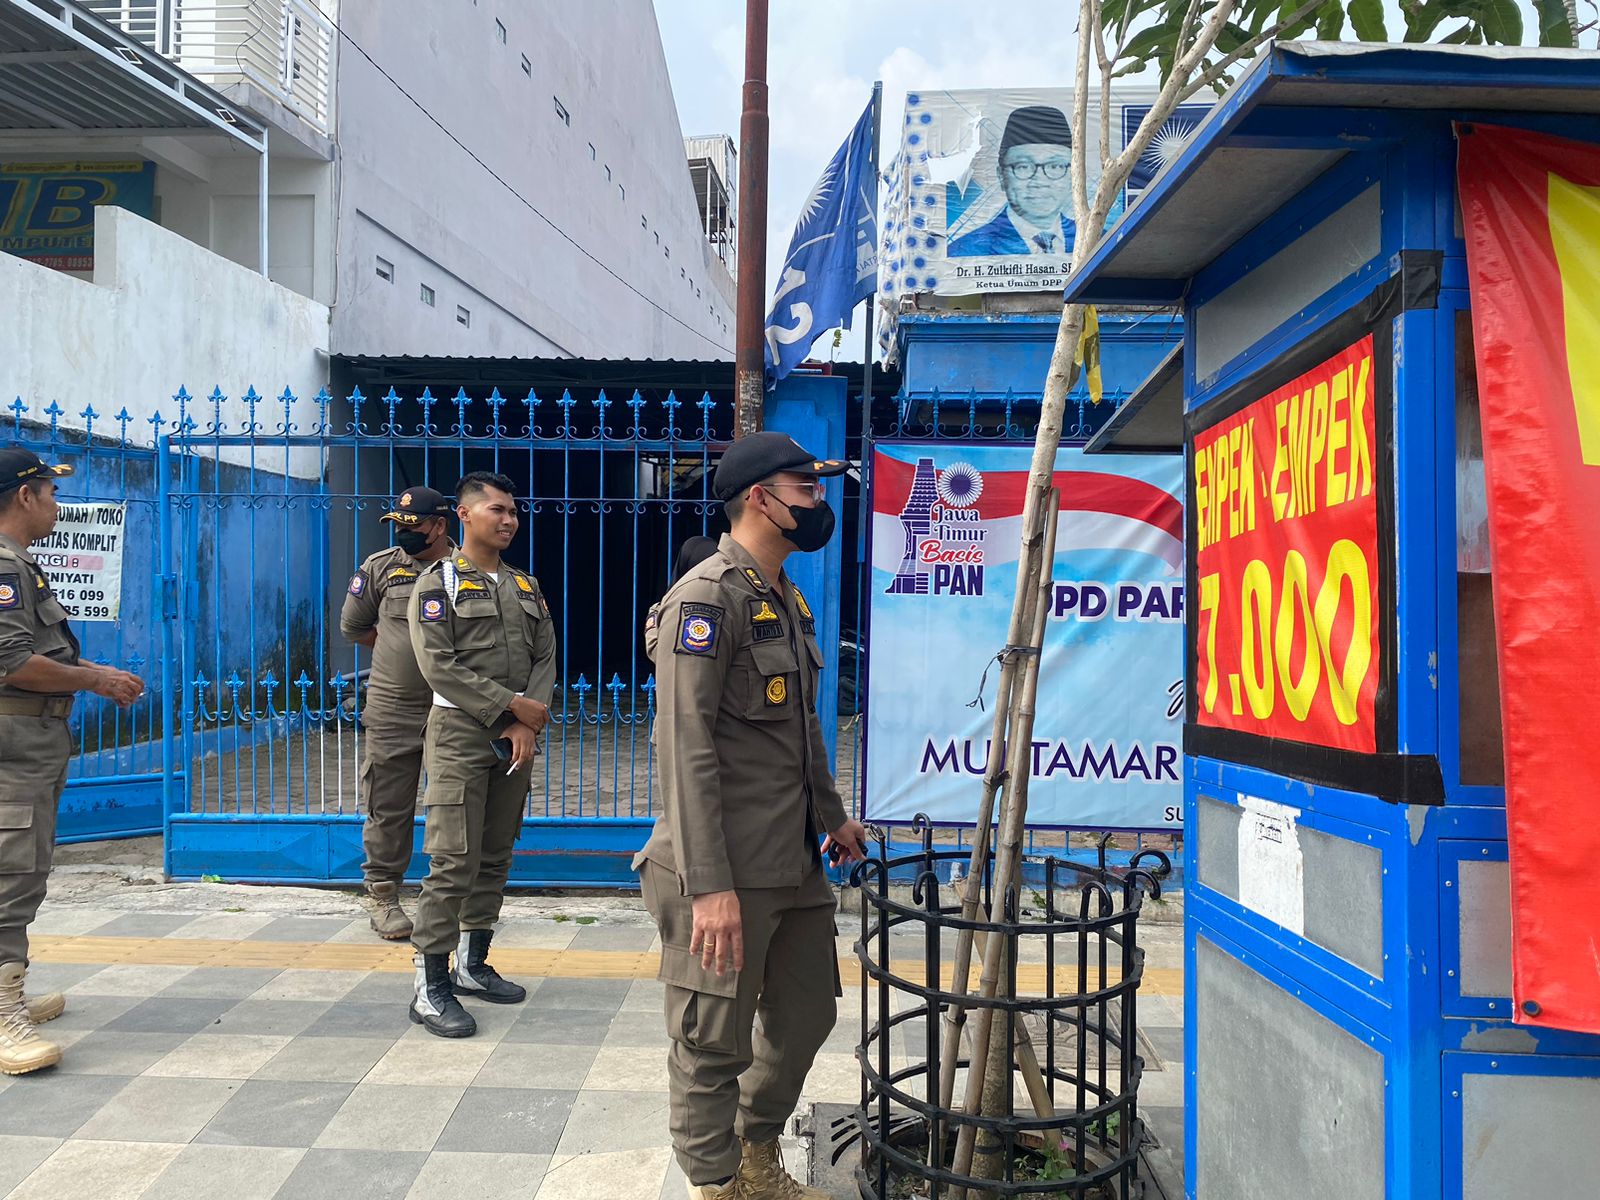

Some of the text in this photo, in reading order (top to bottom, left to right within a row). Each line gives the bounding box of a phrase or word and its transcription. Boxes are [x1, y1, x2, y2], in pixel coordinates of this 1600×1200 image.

[3, 236, 94, 249] MPUTE
[957, 266, 971, 277] Dr.
[974, 265, 985, 276] H.
[987, 263, 1022, 276] Zulkifli
[1026, 263, 1058, 275] Hasan.
[976, 279, 1062, 289] Ketua Umum DPP
[96, 508, 123, 526] TOKO
[933, 504, 979, 523] Jawa
[934, 524, 987, 541] Timur
[72, 532, 117, 552] KOMPLIT
[919, 539, 984, 564] Basis
[934, 564, 984, 596] PAN
[80, 590, 104, 601] 099
[1046, 586, 1107, 618] PD
[84, 606, 109, 617] 599
[1199, 538, 1371, 726] 7.000
[920, 738, 1179, 782] MUTAMAR
